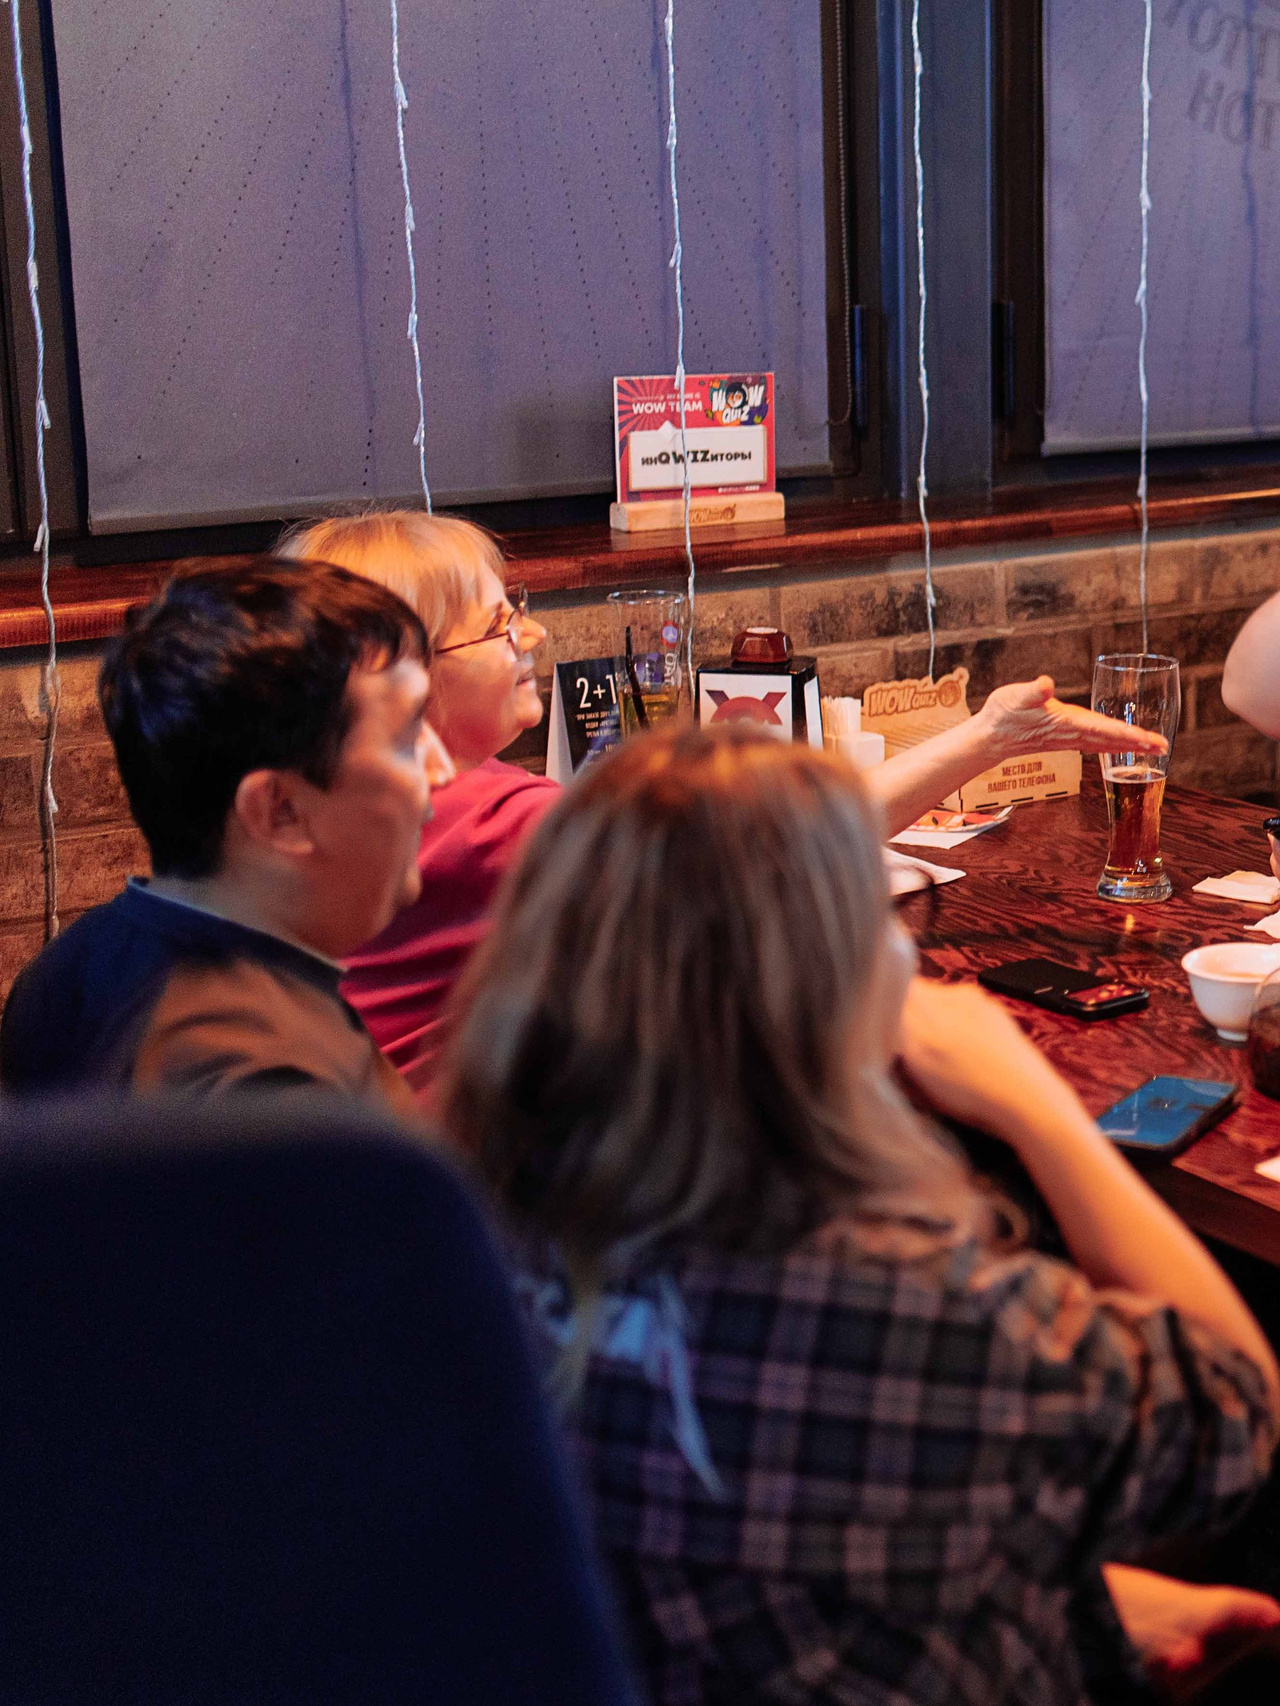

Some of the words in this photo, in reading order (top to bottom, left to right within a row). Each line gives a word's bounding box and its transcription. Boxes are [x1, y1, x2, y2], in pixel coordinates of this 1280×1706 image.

[632, 401, 666, 415] WOW
[668, 400, 703, 412] TEAM
[722, 405, 750, 424] QUIZ
[576, 675, 617, 708] 2+1
[869, 685, 916, 717] WOW
[912, 691, 938, 710] QUIZ
[1002, 764, 1026, 777] МЕСТО
[1026, 761, 1043, 775] ДЛЯ
[987, 779, 1017, 793] ВАШЕГО
[1018, 773, 1056, 789] ТЕЛЕФОНА
